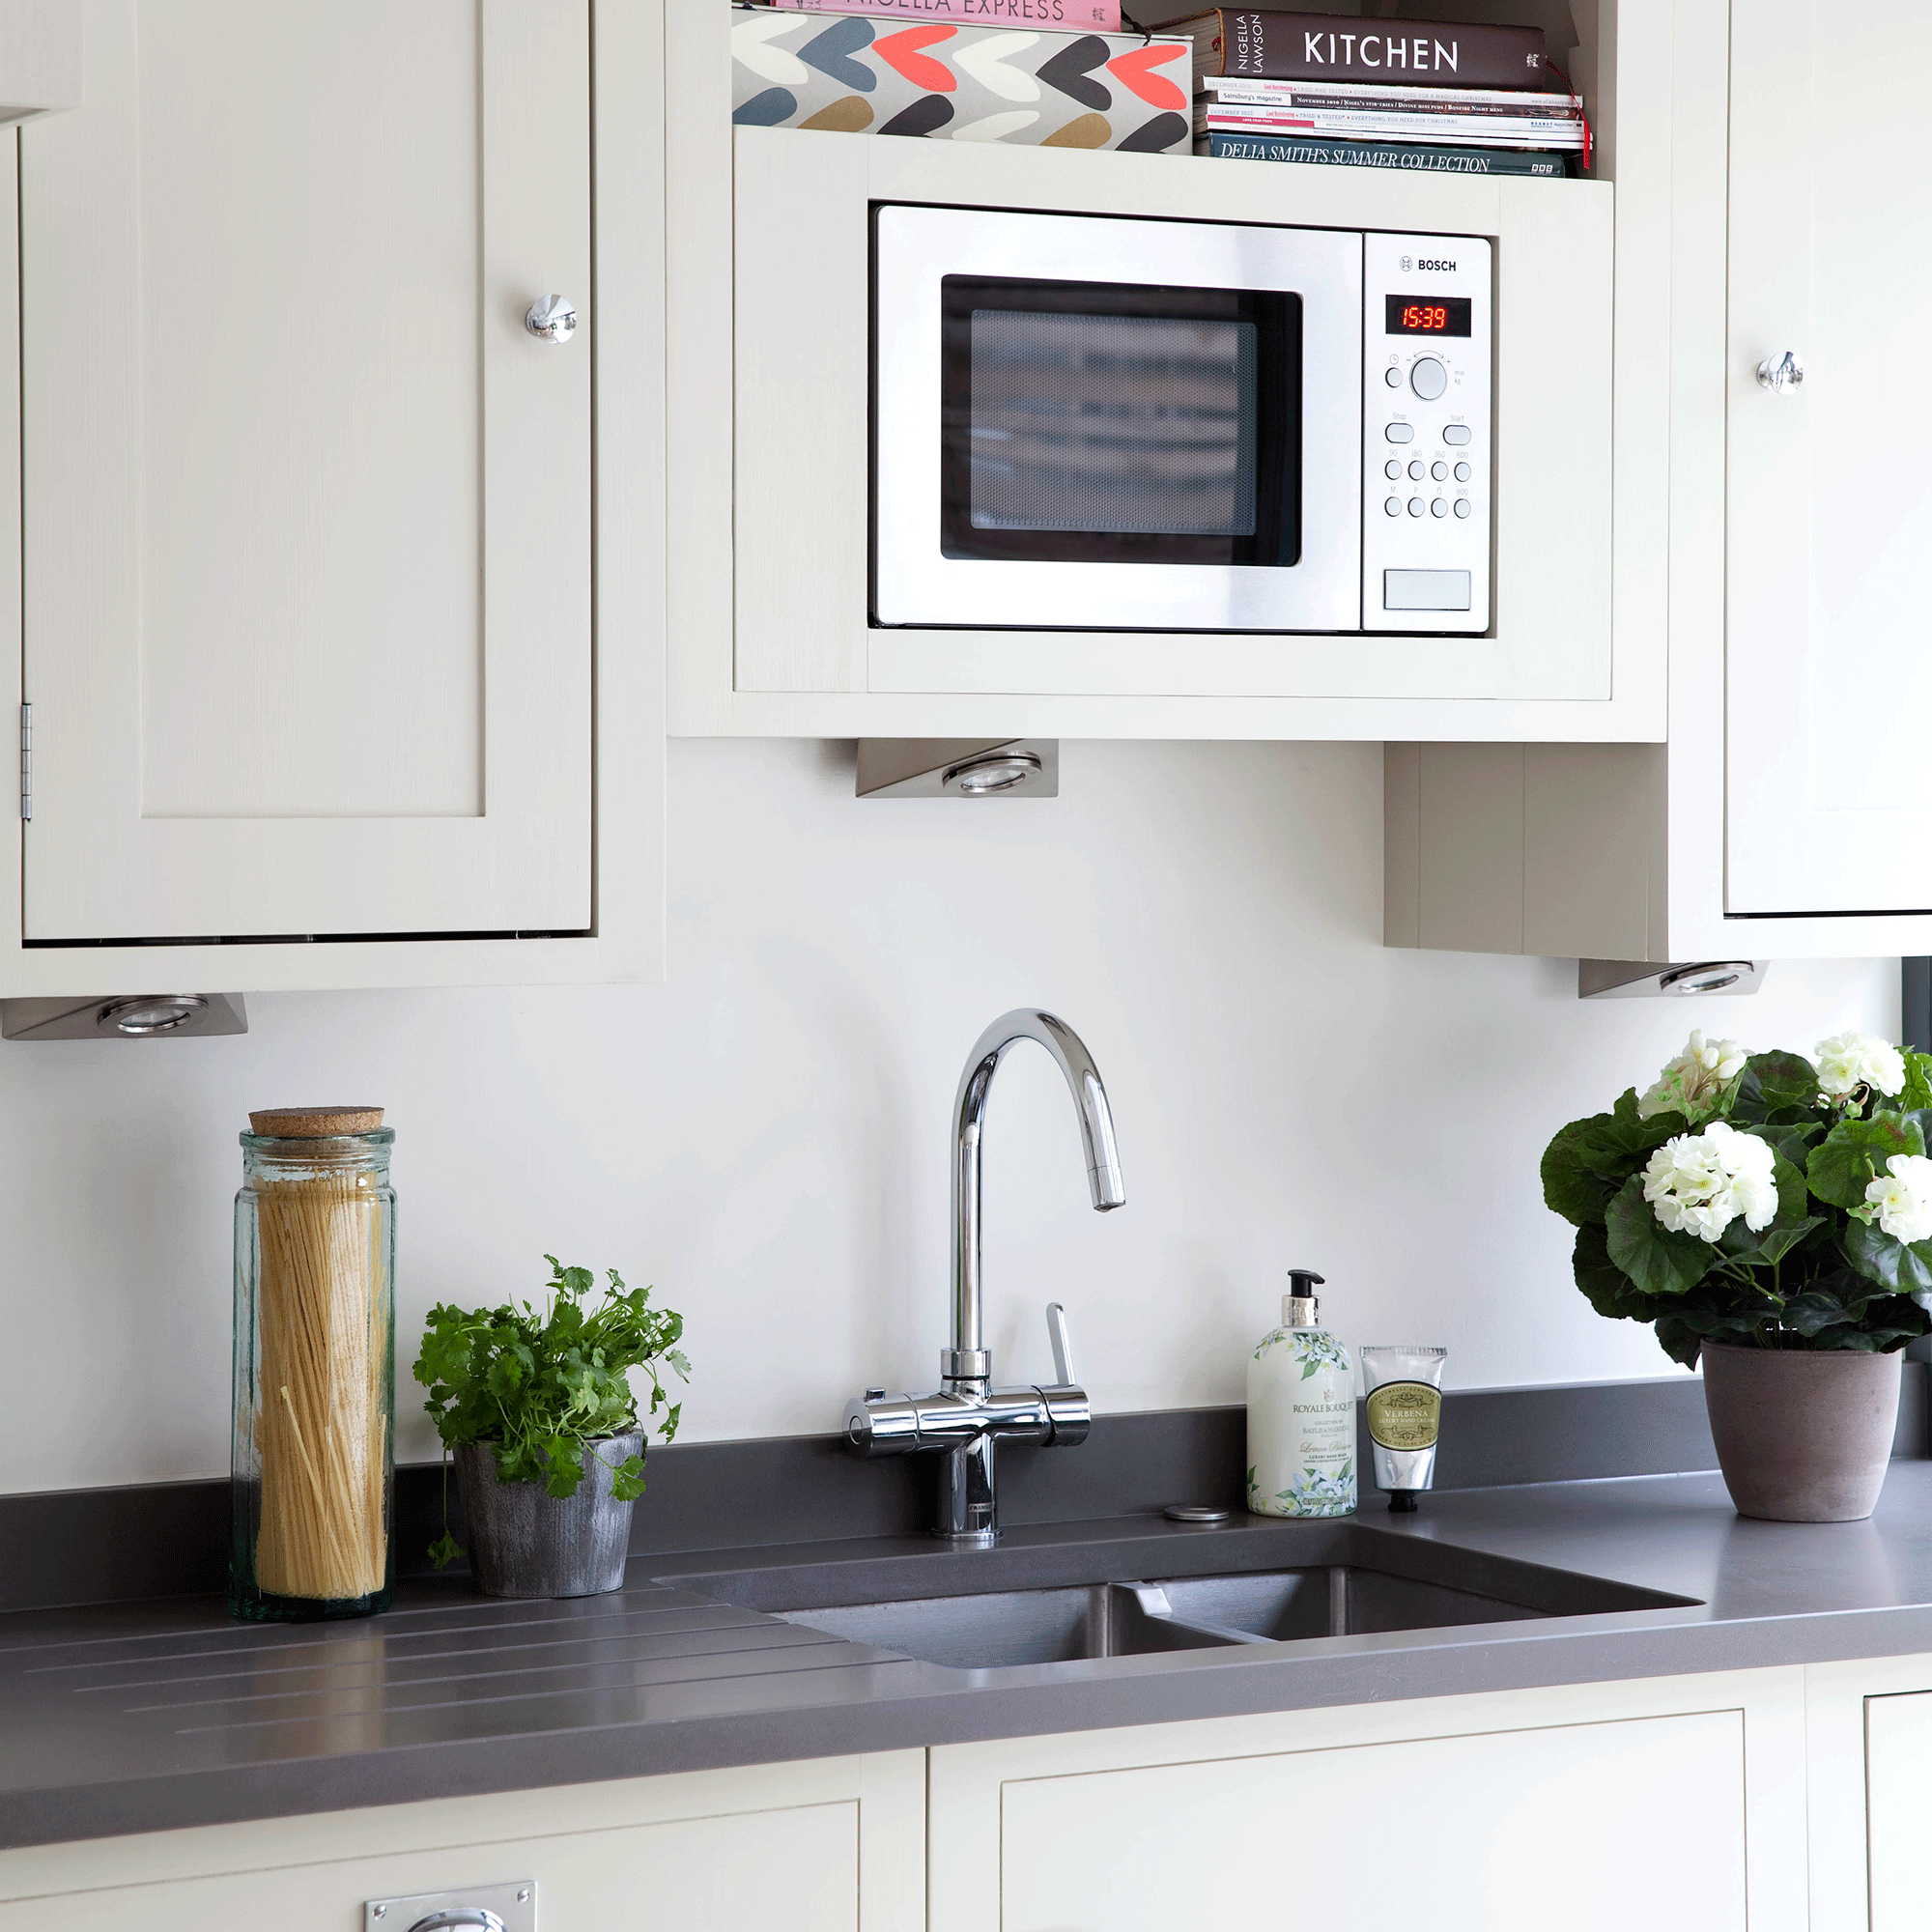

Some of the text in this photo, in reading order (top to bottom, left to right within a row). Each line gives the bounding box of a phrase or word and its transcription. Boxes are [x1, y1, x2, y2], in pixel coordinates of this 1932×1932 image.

[963, 0, 1065, 20] EXPRESS
[1236, 15, 1248, 70] NIGELLA
[1250, 14, 1264, 73] LAWSON
[1304, 32, 1458, 73] KITCHEN
[1223, 93, 1255, 101] Sainsbury's
[1219, 143, 1491, 173] DELIA SMITH'S SUMMER COLLECTION
[1418, 260, 1457, 271] BOSCH
[1403, 305, 1446, 328] 15:39
[1392, 412, 1407, 421] Stop
[1450, 413, 1465, 422] Start
[1410, 449, 1422, 458] 180
[1434, 450, 1446, 459] 360
[1293, 1401, 1353, 1413] ROYALE BOUQUET
[1298, 1441, 1327, 1453] Lemon
